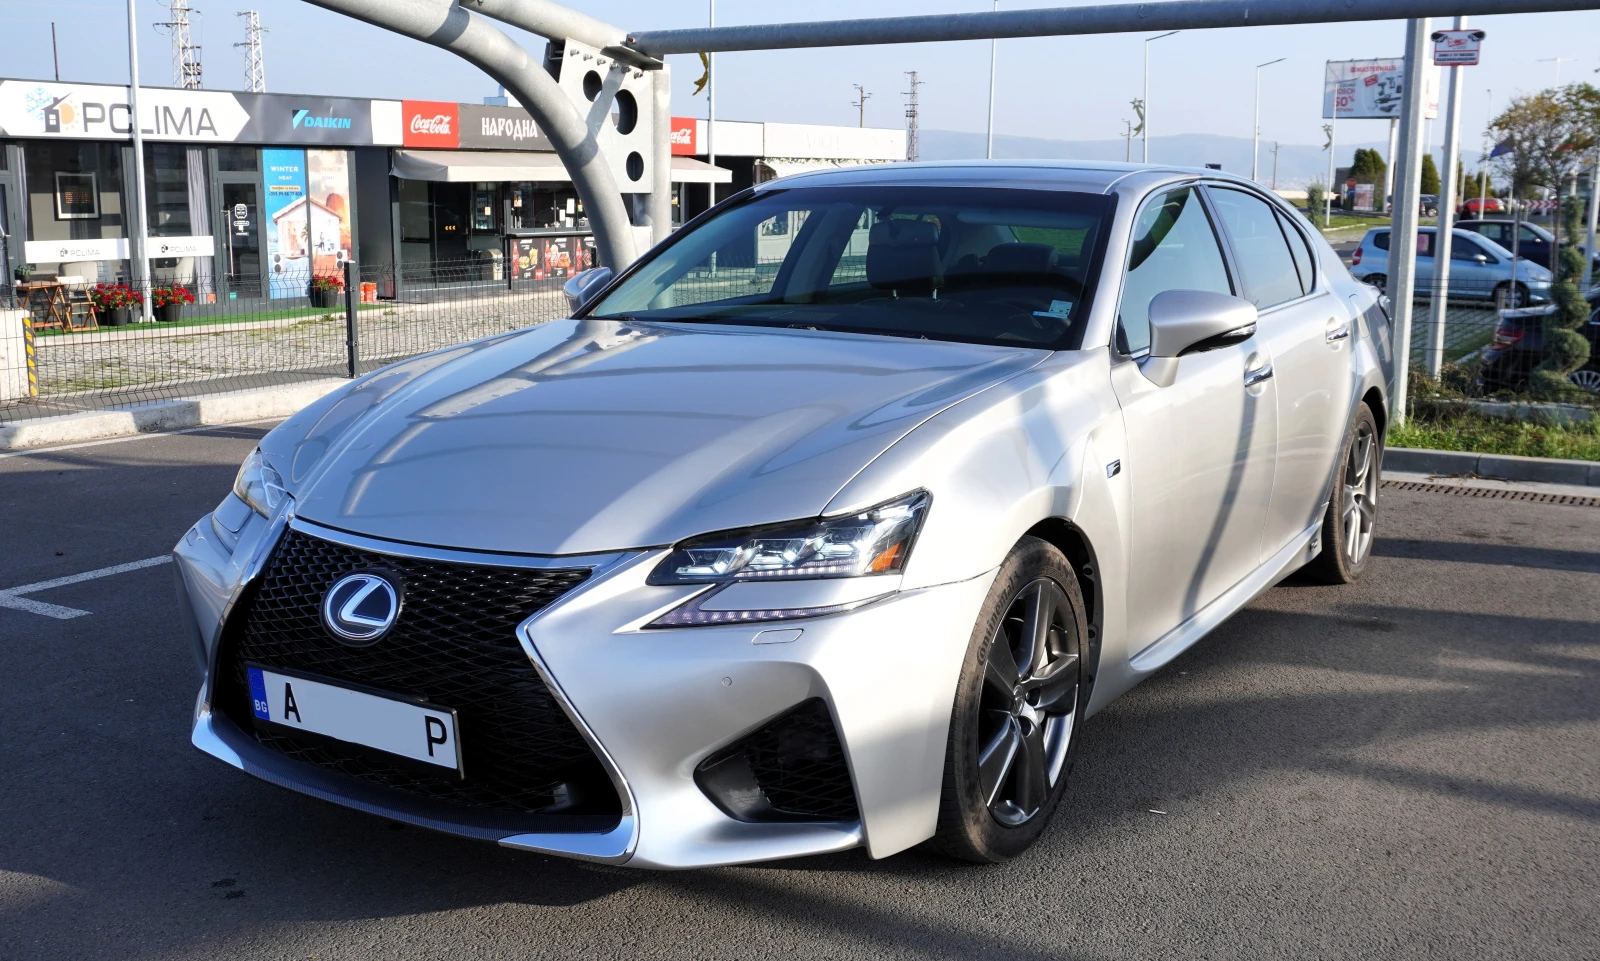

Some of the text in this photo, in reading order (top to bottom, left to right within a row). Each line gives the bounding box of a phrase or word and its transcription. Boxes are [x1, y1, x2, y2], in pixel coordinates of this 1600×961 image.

[1356, 65, 1396, 73] MASTERHAUS
[304, 116, 351, 129] DAIKIN
[410, 113, 451, 134] Coca-Cola
[481, 117, 538, 141] НАРОДНА
[976, 576, 1015, 666] Continental
[254, 699, 268, 713] BG
[284, 682, 447, 757] A P
